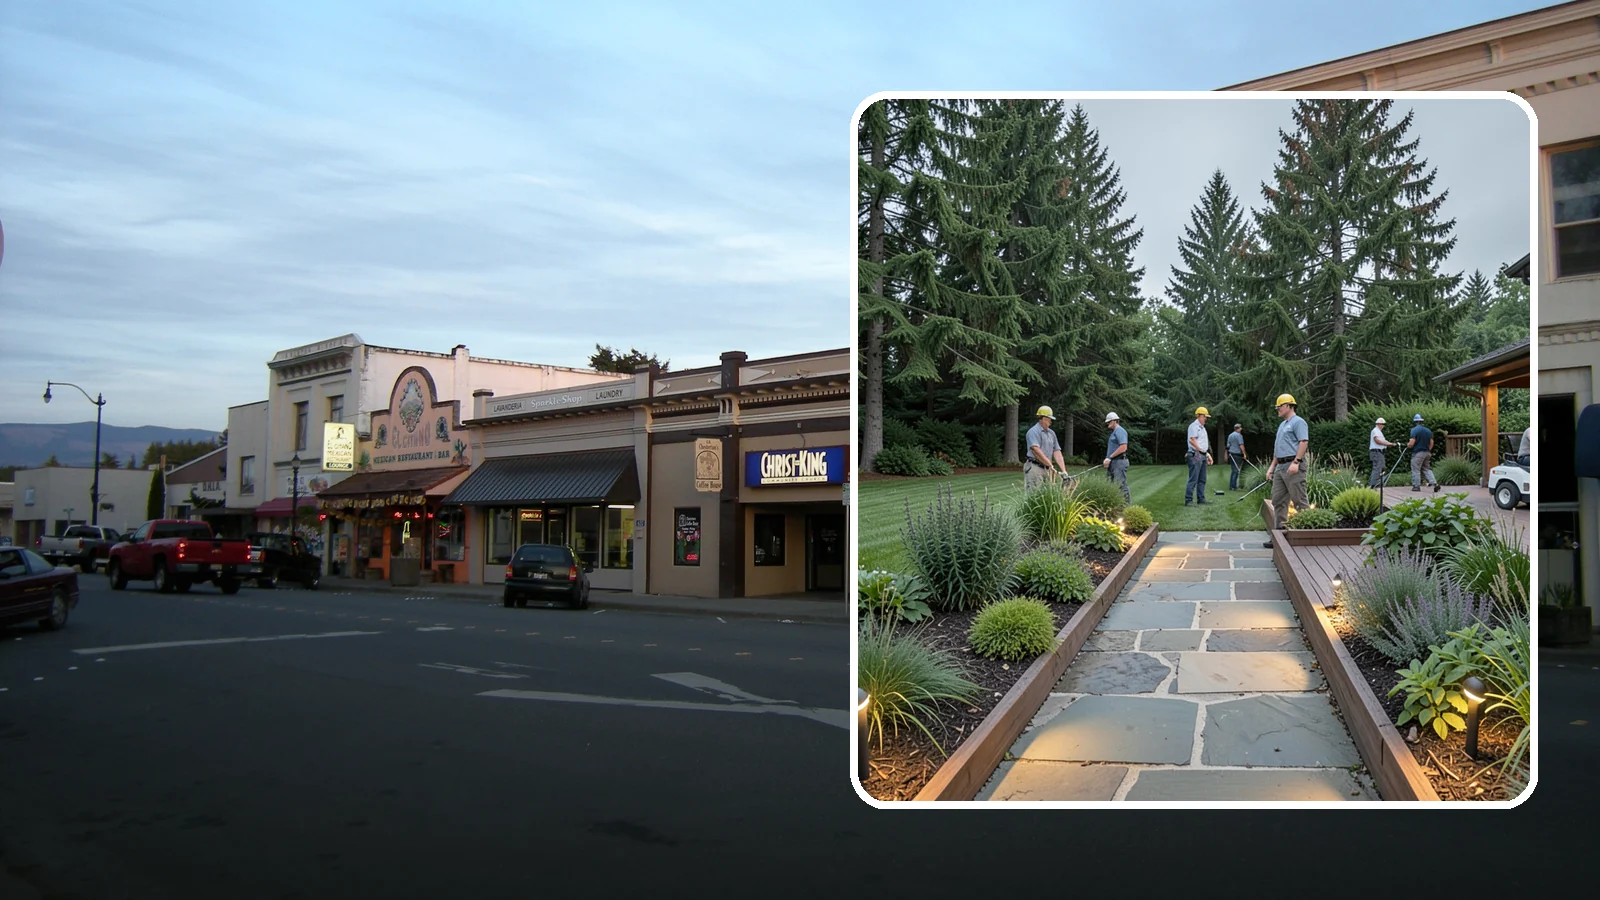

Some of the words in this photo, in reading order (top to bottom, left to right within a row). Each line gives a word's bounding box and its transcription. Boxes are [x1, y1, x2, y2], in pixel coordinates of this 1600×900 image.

[561, 394, 583, 404] Shop
[595, 389, 623, 400] LAUNDRY
[493, 402, 522, 412] LAVANDERIA
[397, 451, 434, 462] RESTAURANT
[438, 450, 450, 459] BAR
[761, 452, 797, 477] CHRIST
[799, 450, 827, 476] KING
